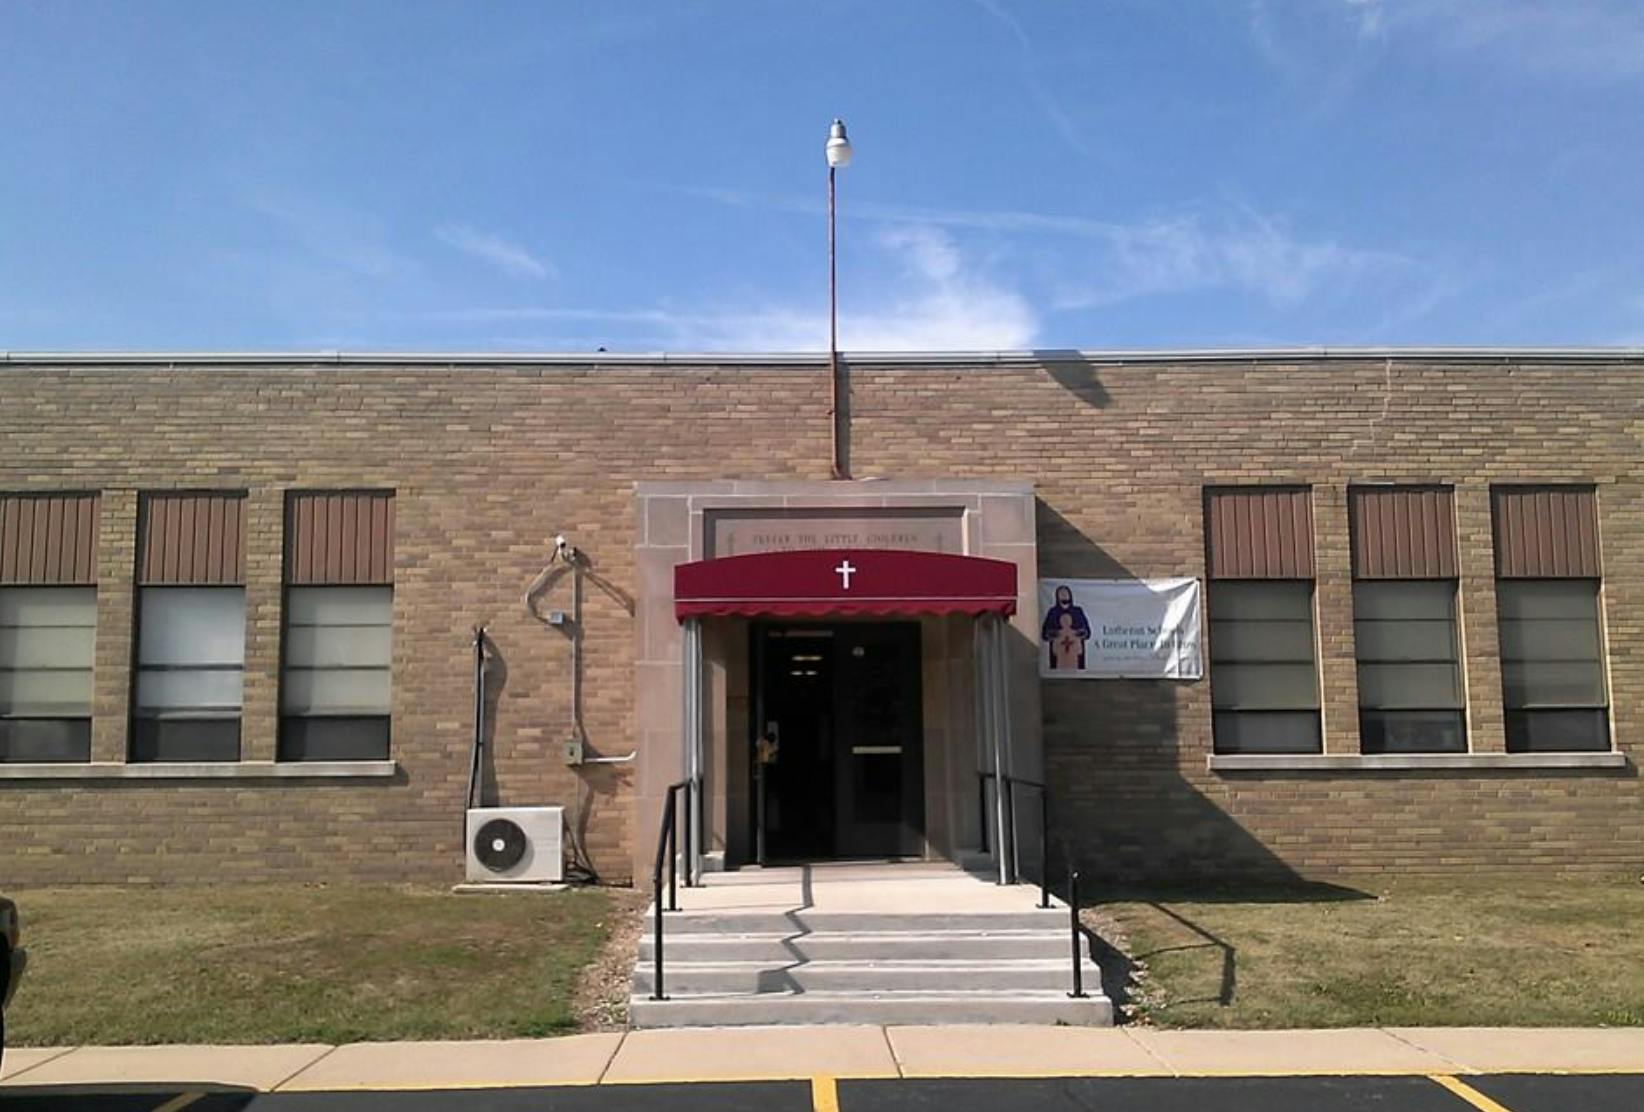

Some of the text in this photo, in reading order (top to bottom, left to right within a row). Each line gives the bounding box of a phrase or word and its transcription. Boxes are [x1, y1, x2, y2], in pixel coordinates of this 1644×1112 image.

[798, 534, 817, 545] THE
[823, 534, 859, 545] LITTLE
[1103, 624, 1145, 635] Lutheran
[1103, 639, 1127, 649] Great
